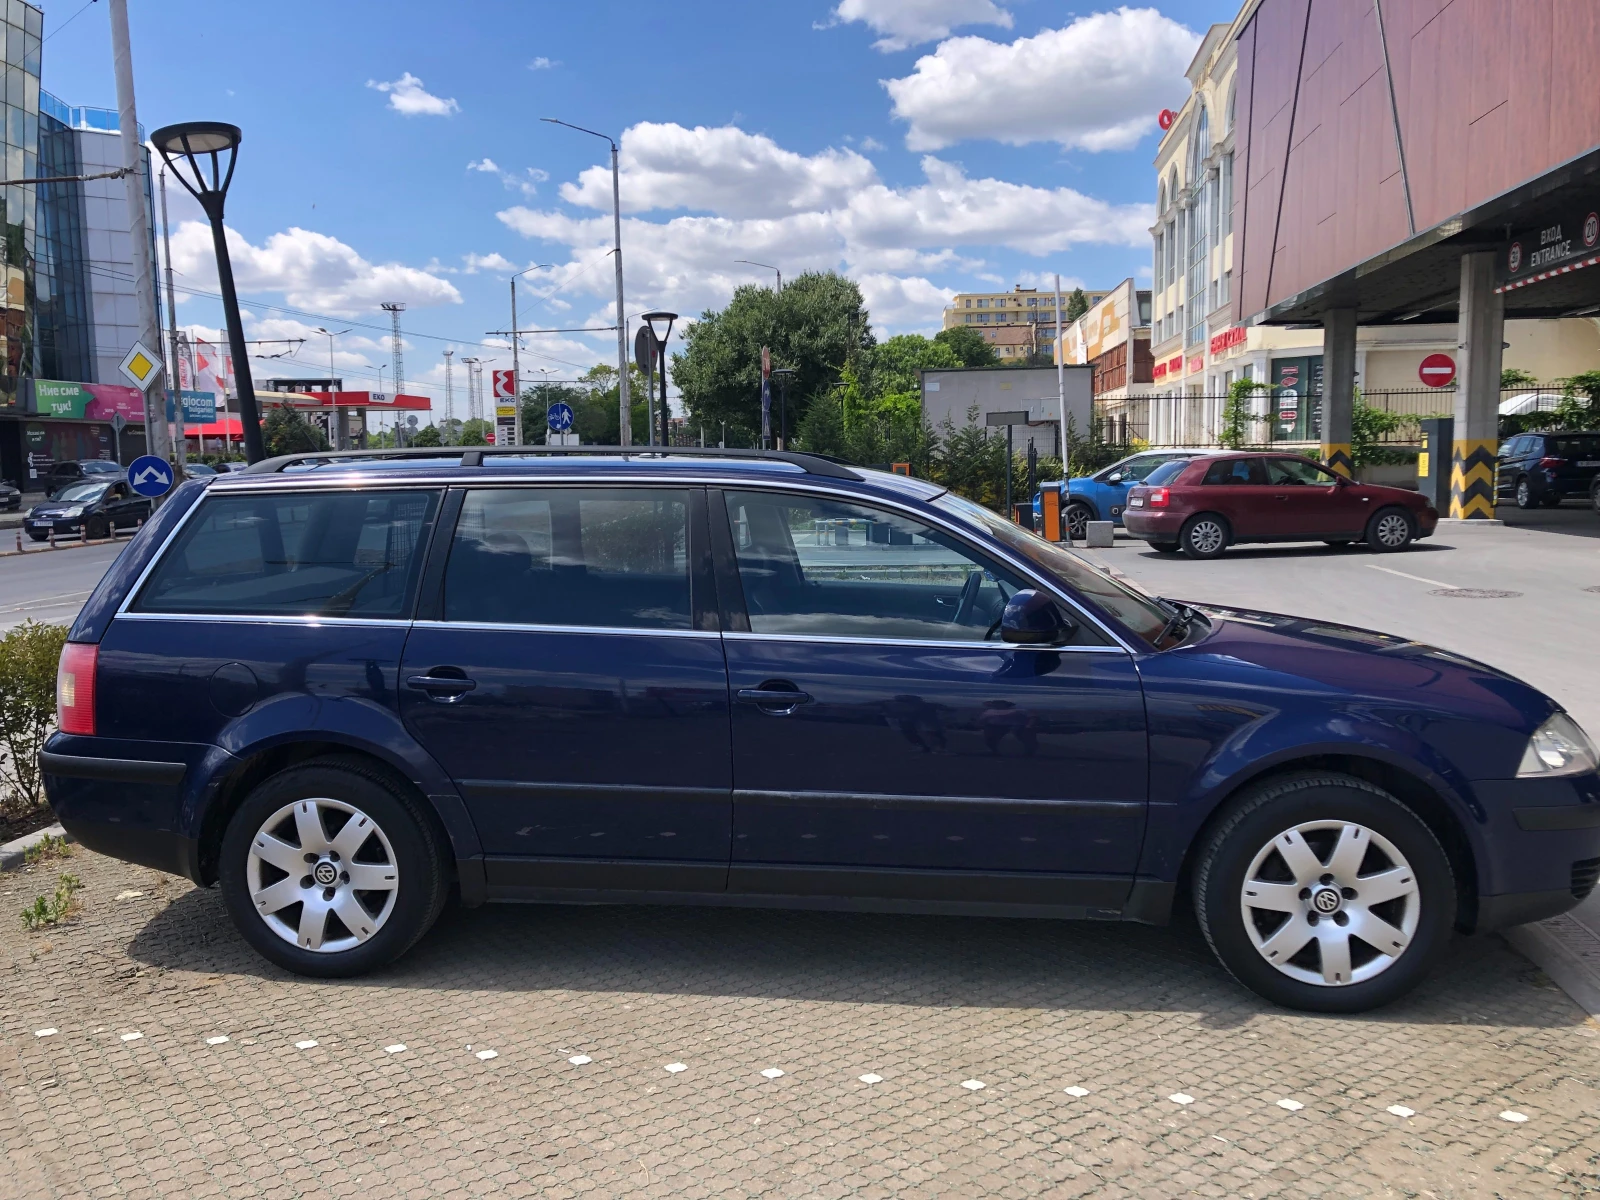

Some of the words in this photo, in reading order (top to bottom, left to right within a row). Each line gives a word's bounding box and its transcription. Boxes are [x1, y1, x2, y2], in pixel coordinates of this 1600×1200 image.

[1540, 224, 1562, 245] ВХОД
[1586, 220, 1596, 238] 20
[1530, 240, 1571, 267] ENTRANCE
[39, 384, 59, 396] Ние
[60, 387, 79, 396] сме
[372, 393, 385, 401] EKO
[51, 400, 72, 414] тук!
